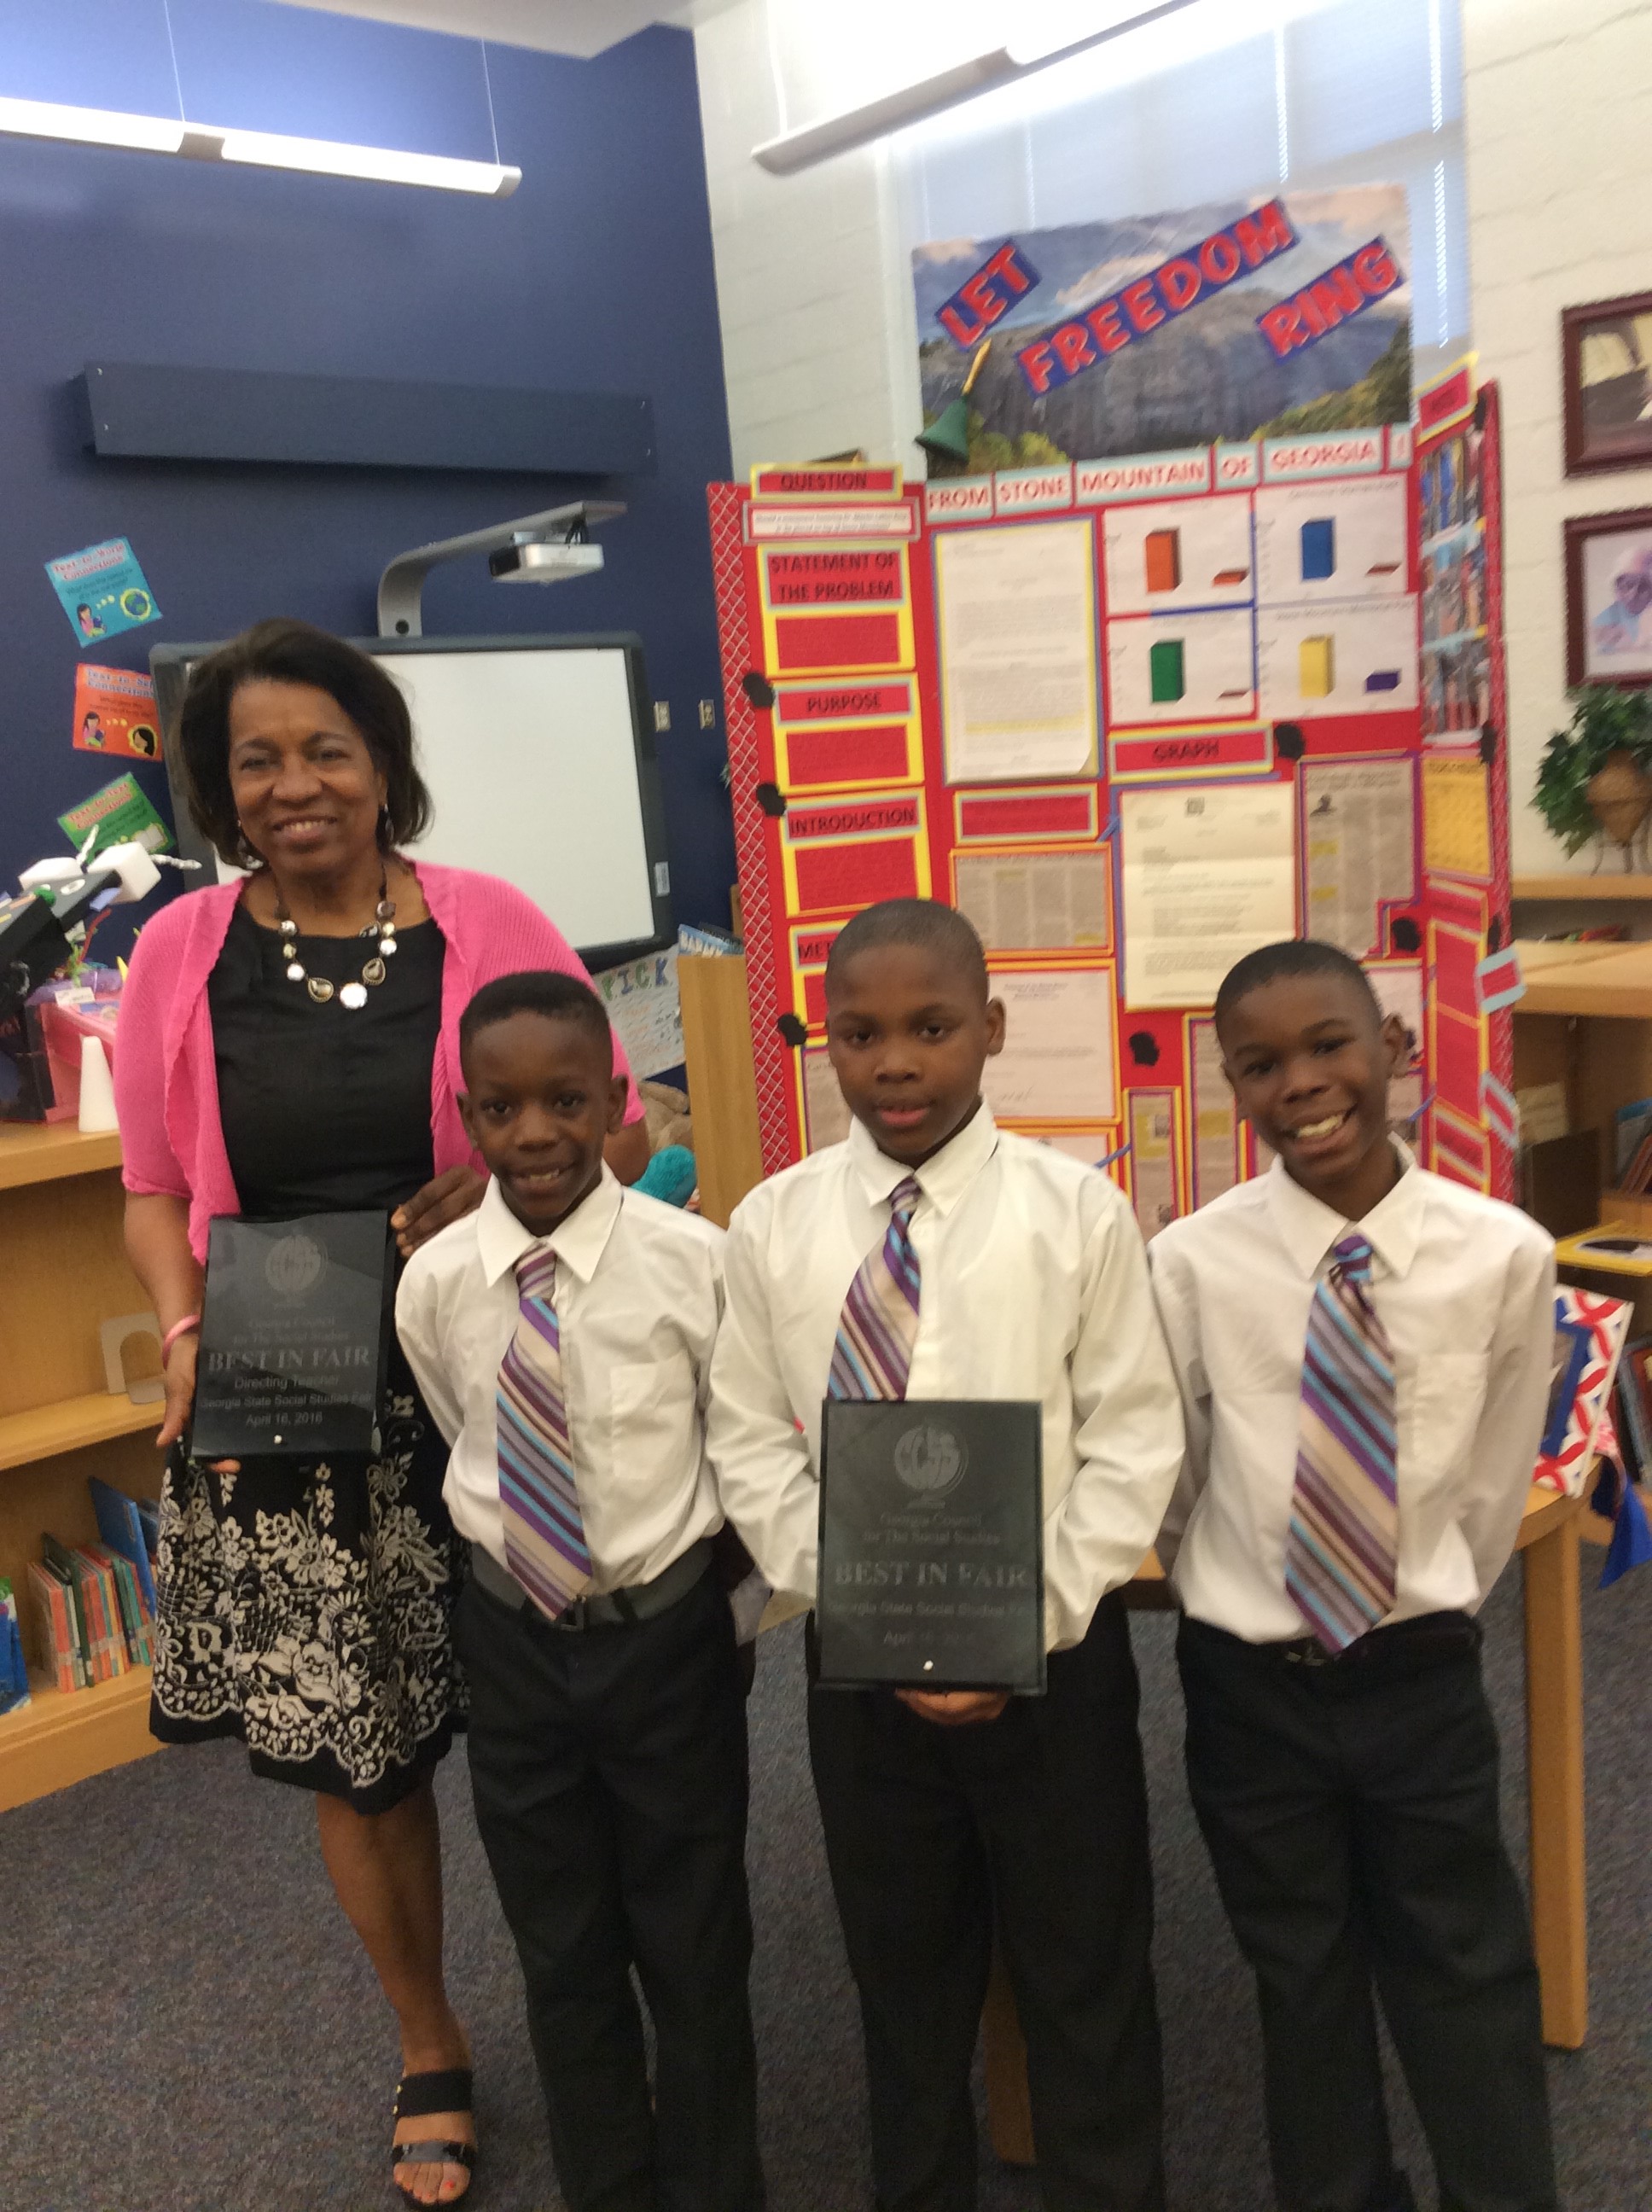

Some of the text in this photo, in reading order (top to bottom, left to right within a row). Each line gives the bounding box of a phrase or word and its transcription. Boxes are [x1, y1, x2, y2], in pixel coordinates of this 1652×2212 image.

[939, 247, 1031, 346] LET
[1019, 201, 1295, 394] FREEDOM
[1259, 243, 1399, 358] RING
[780, 472, 867, 491] QUESTION
[928, 487, 990, 510] FROM
[1000, 476, 1066, 504] STONE
[1081, 462, 1205, 492] MOUNTAIN
[1221, 457, 1251, 480] OF
[1270, 440, 1377, 471] GEORGIA
[771, 552, 894, 574] STATEMENT OF
[778, 580, 893, 601] THE PROBLEM
[806, 692, 881, 713] PURPOSE
[1152, 739, 1220, 761] GRAPH
[789, 807, 915, 835] INTRODUCTION
[208, 1345, 369, 1371] BEST IN FAIR
[234, 1376, 288, 1391] Directing
[835, 1560, 1031, 1589] BEST IN FAIR
